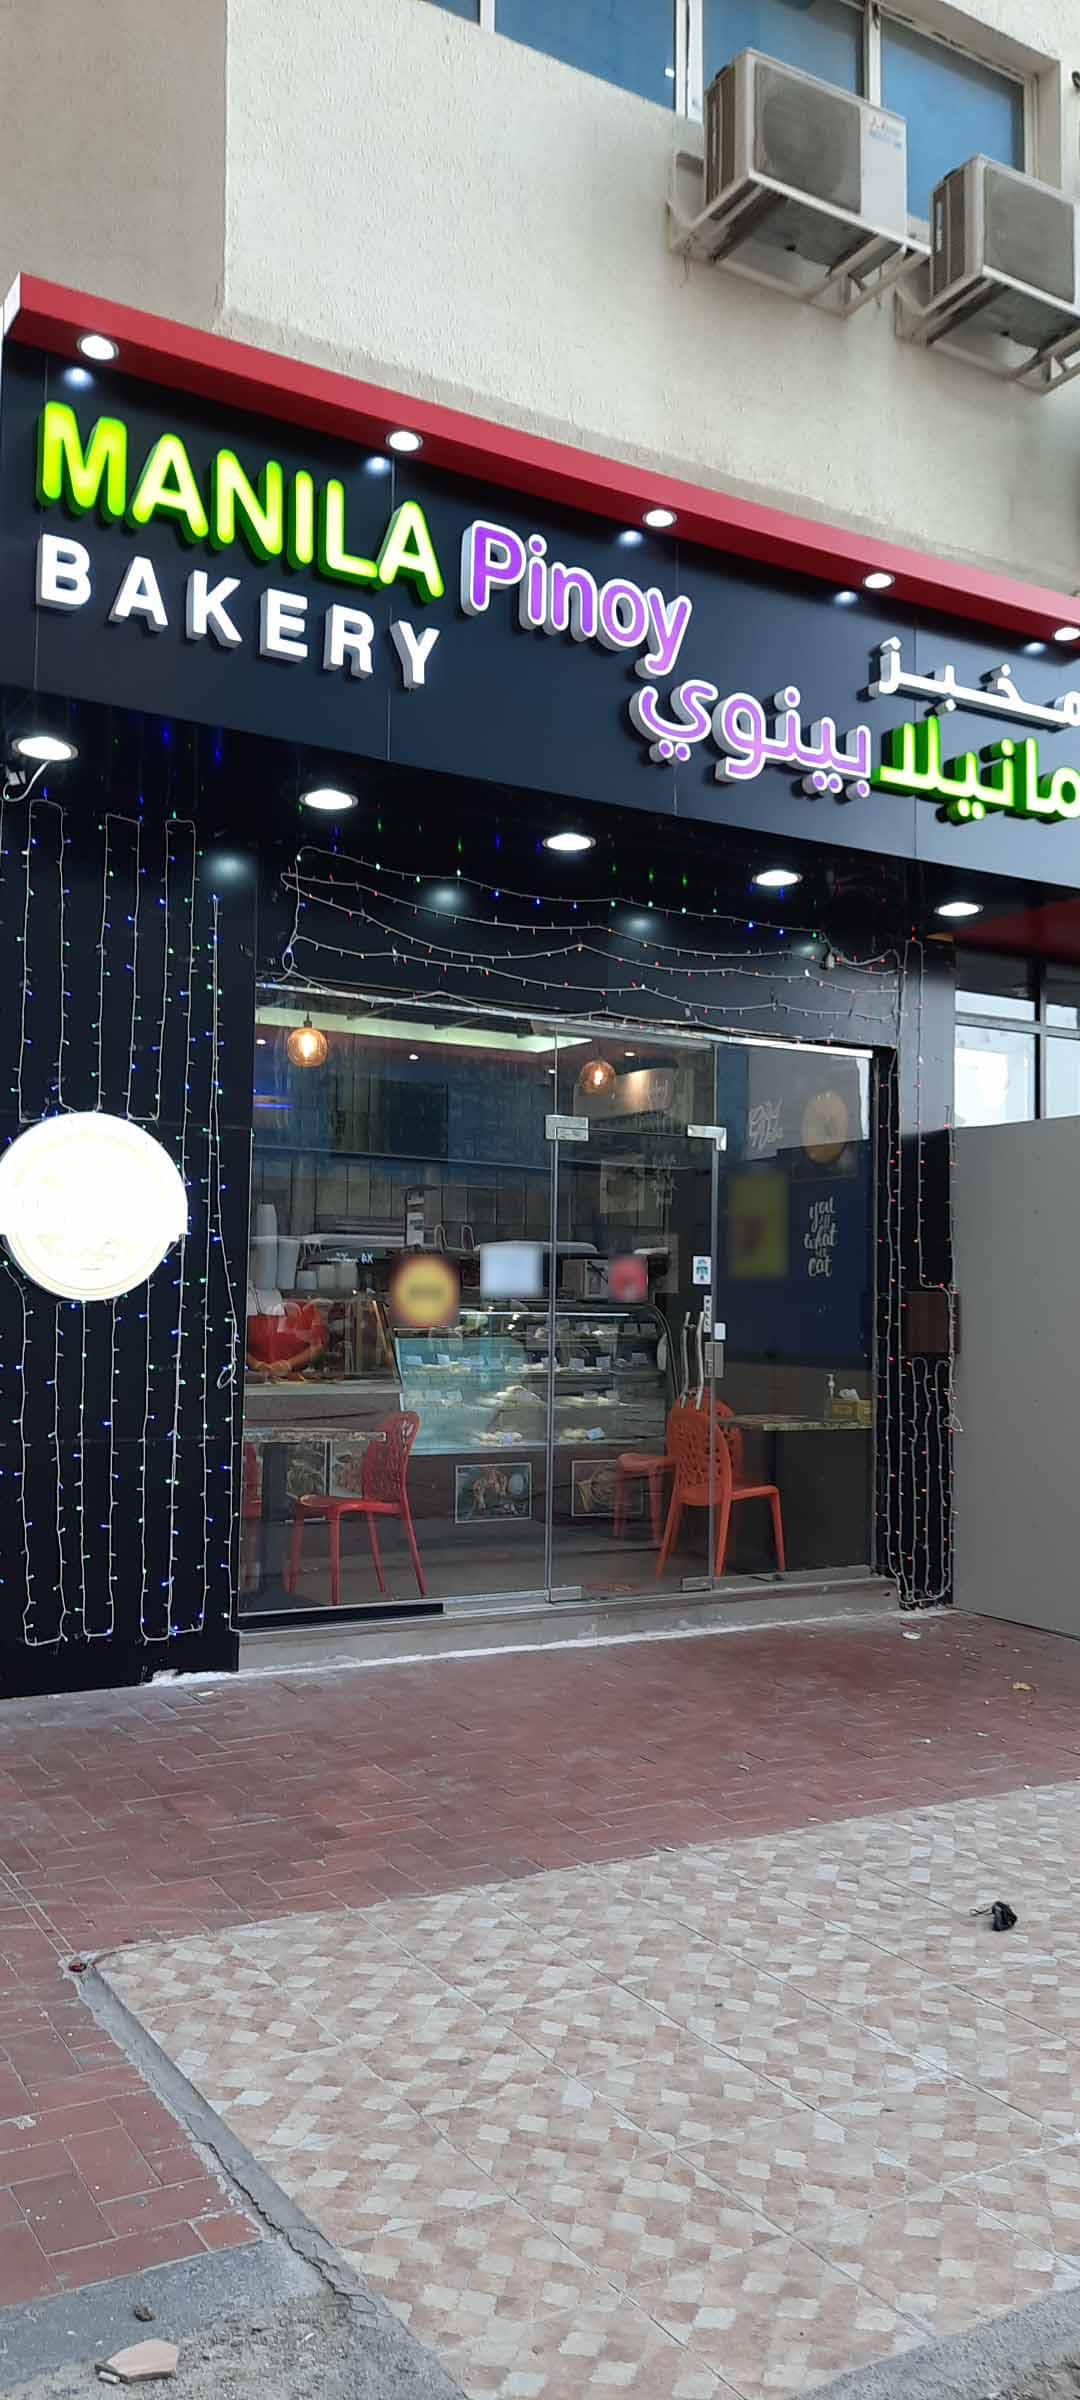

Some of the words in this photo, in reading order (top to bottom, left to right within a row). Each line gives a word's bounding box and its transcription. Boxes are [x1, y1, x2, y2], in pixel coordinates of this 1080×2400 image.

[38, 401, 445, 601] MANILA
[462, 520, 692, 677] Pinoy
[37, 533, 440, 688] BAKERY
[631, 679, 871, 799] بينوي
[874, 715, 1080, 820] مانيلا
